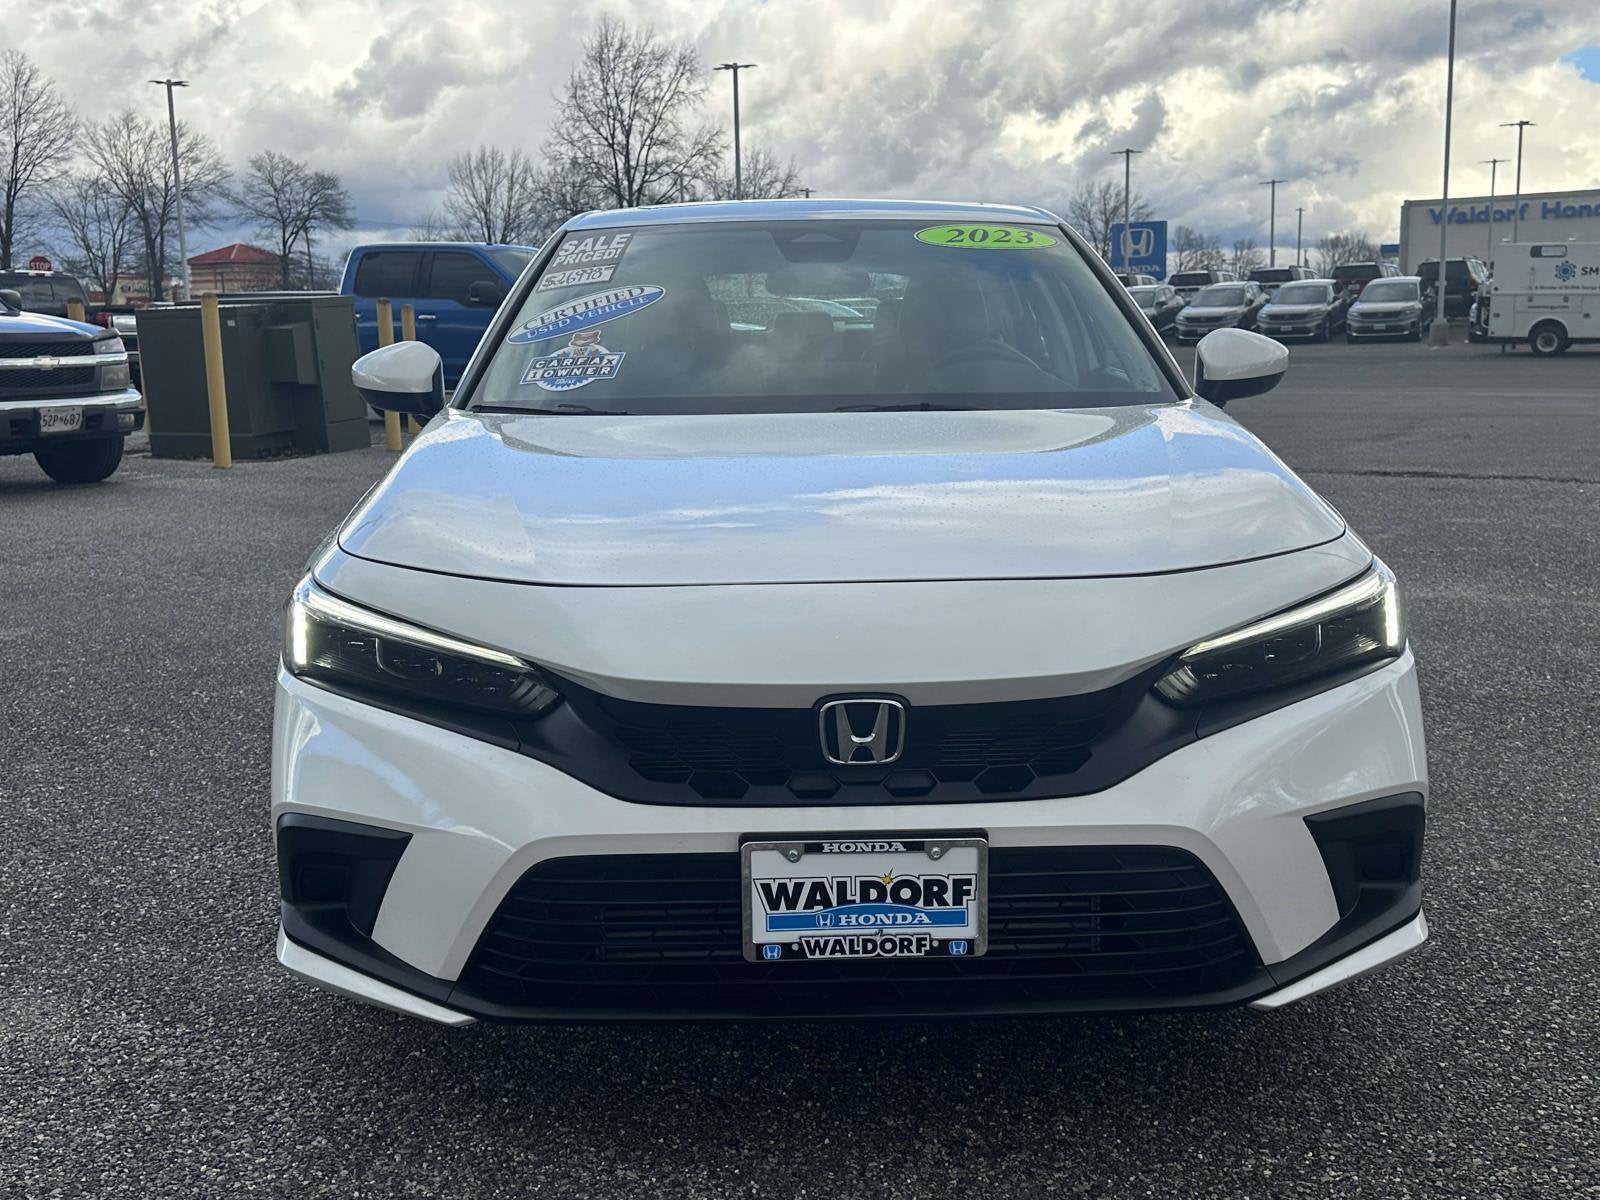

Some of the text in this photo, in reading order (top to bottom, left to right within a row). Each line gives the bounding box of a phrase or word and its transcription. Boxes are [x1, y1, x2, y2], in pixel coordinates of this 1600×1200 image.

[1428, 202, 1529, 224] Waldorf
[558, 233, 631, 256] SALE
[945, 228, 1034, 244] 2023
[30, 261, 50, 270] STOP
[553, 248, 622, 267] PRICED!
[523, 287, 646, 331] CERTIFIED
[527, 296, 649, 339] USED VEHICLE
[534, 356, 616, 369] CARFAX
[544, 367, 611, 378] OWNER
[822, 841, 907, 853] HONDA
[757, 876, 976, 912] WALDORF
[838, 912, 933, 926] HONDA
[802, 935, 931, 958] WALDORF
